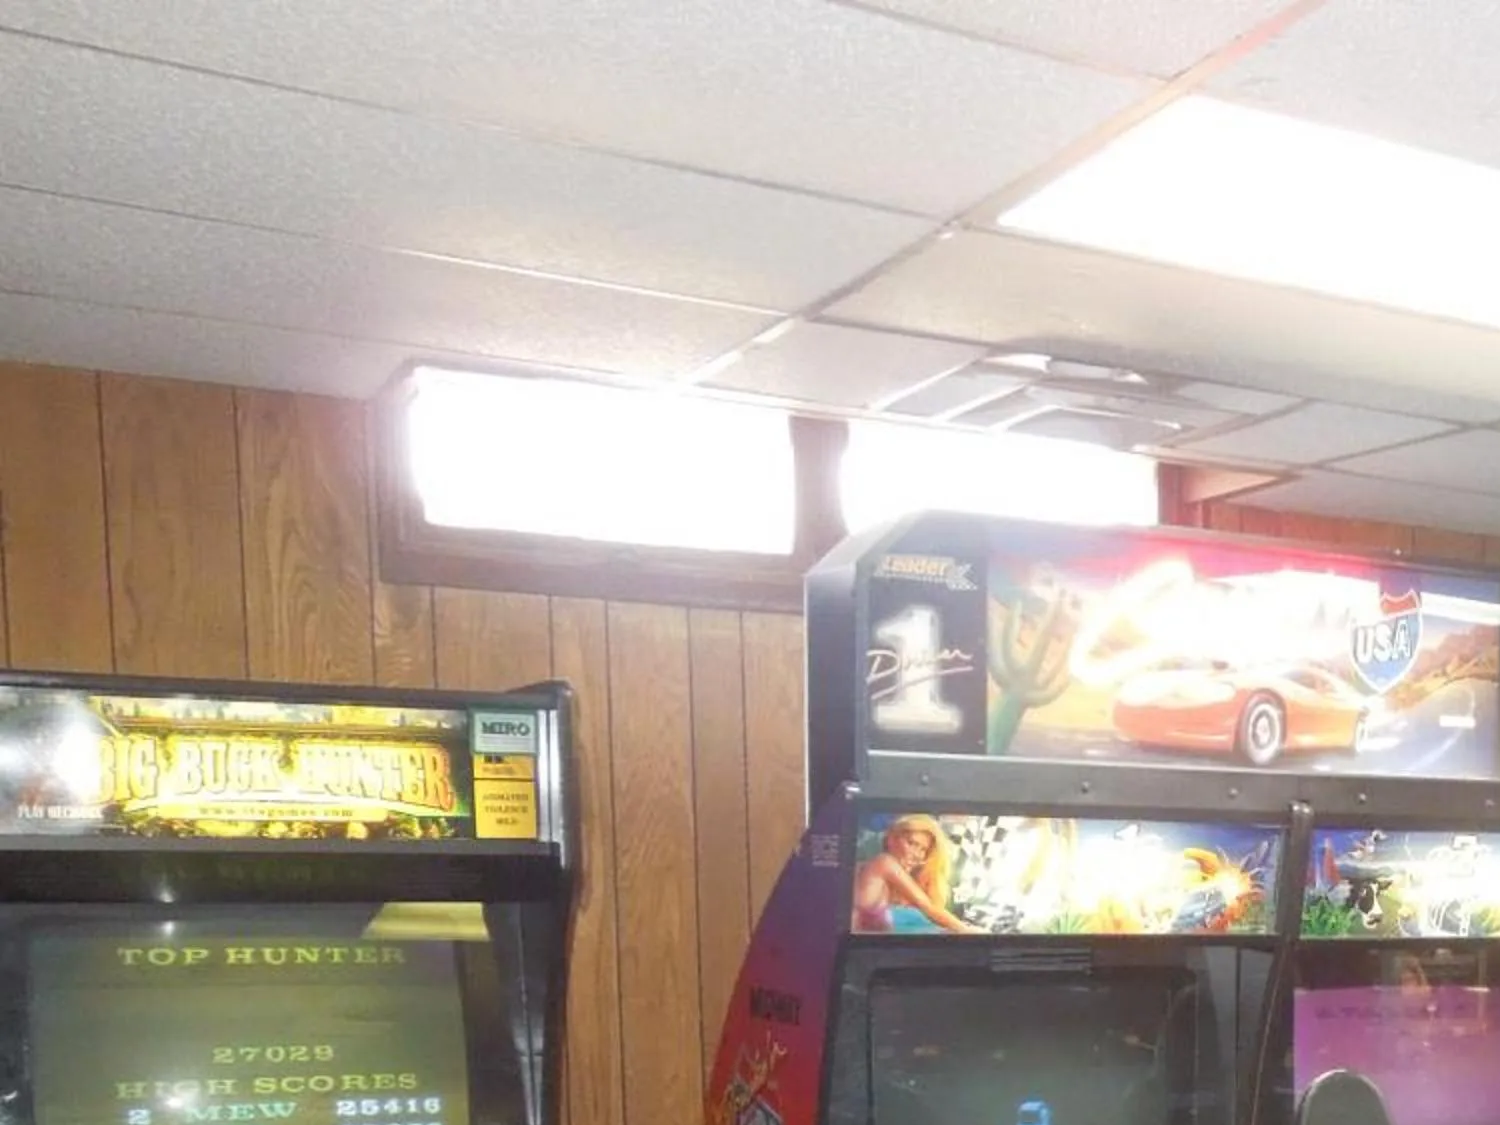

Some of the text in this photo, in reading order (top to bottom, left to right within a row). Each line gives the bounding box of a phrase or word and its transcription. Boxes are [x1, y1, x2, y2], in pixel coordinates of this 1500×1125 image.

[1354, 619, 1411, 663] USA
[97, 735, 456, 812] BIG BUCK HUNTER
[118, 946, 406, 966] TOP HUNTER
[212, 1045, 335, 1063] 27029
[115, 1073, 418, 1101] HIGH SCORES
[184, 1102, 299, 1124] MEW
[336, 1097, 441, 1117] 25416
